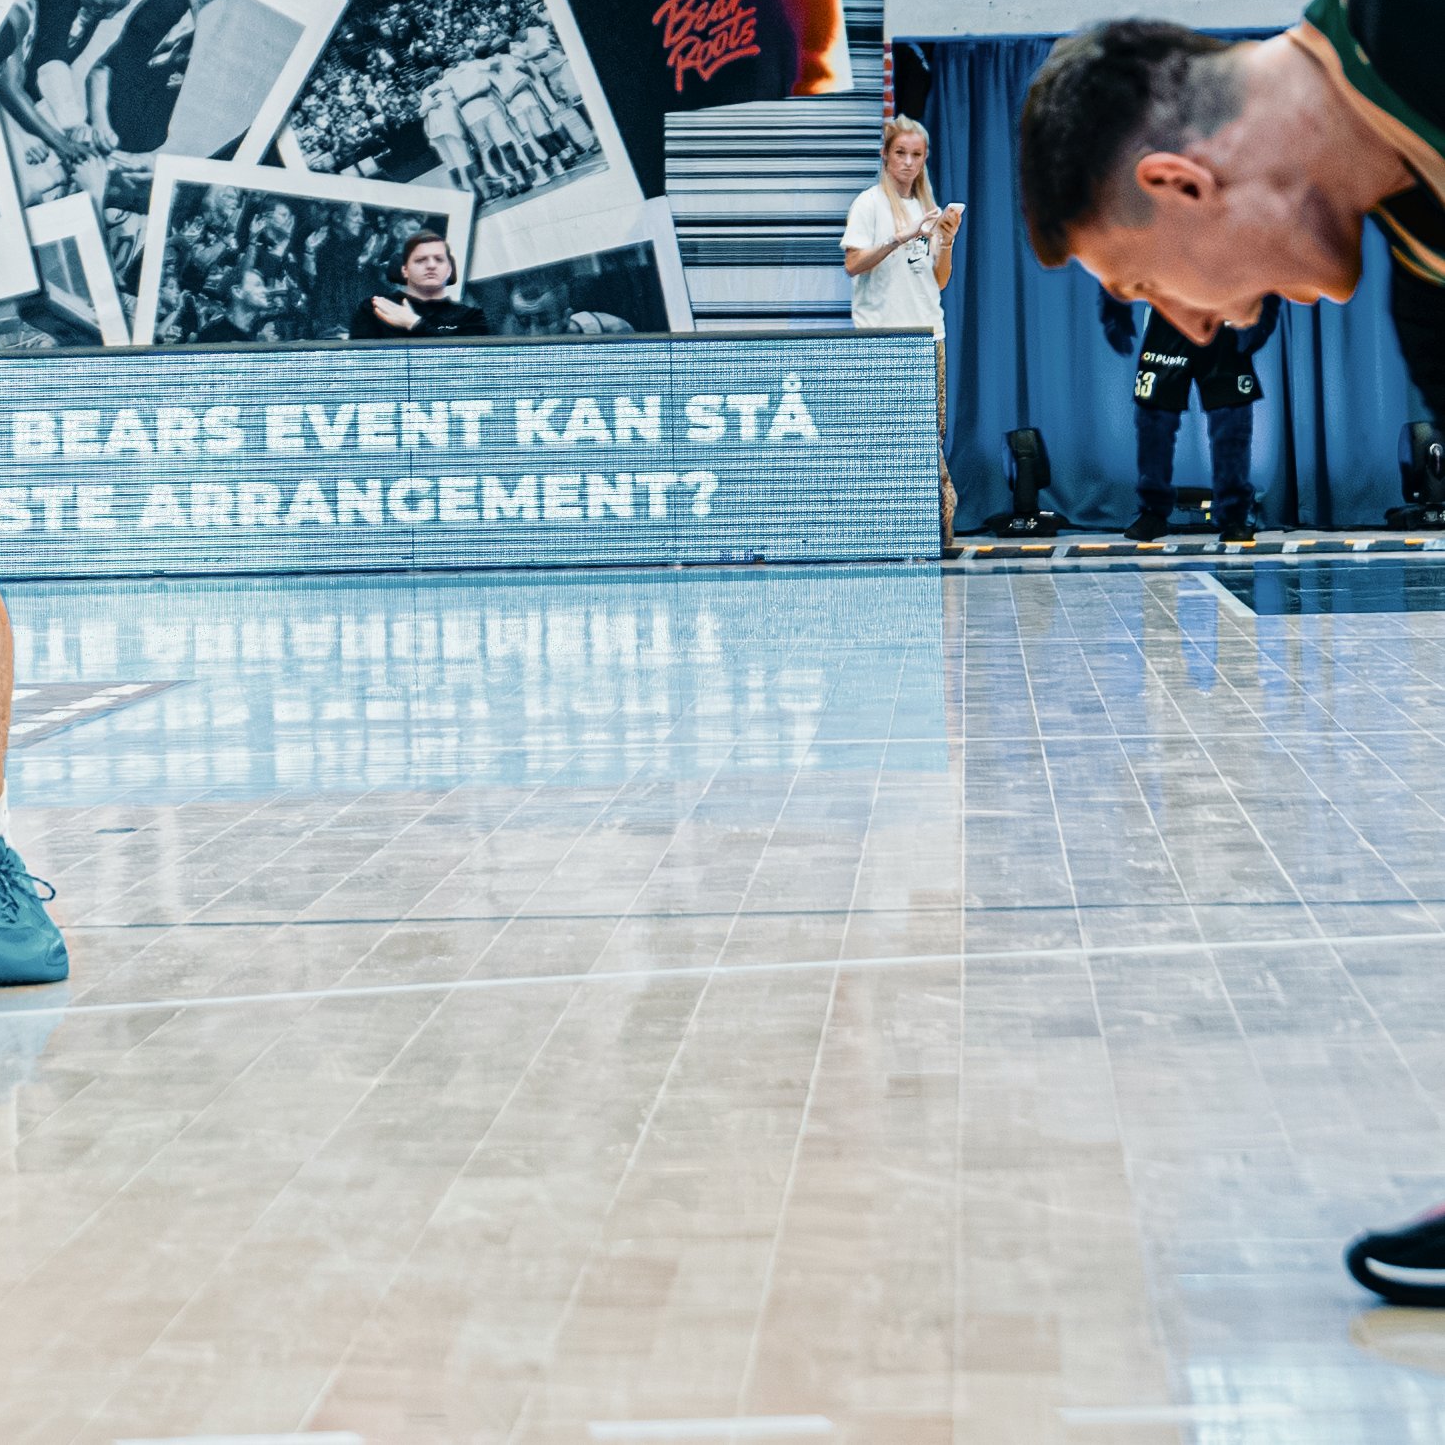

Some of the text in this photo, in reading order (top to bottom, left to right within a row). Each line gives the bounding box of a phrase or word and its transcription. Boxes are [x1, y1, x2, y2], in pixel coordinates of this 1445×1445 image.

[667, 7, 761, 92] Roots
[12, 405, 245, 456] BEARS
[264, 400, 492, 451] EVENT
[514, 396, 661, 446] KAN
[683, 372, 820, 443] STÅ
[137, 471, 719, 529] ARRANGEMENT?
